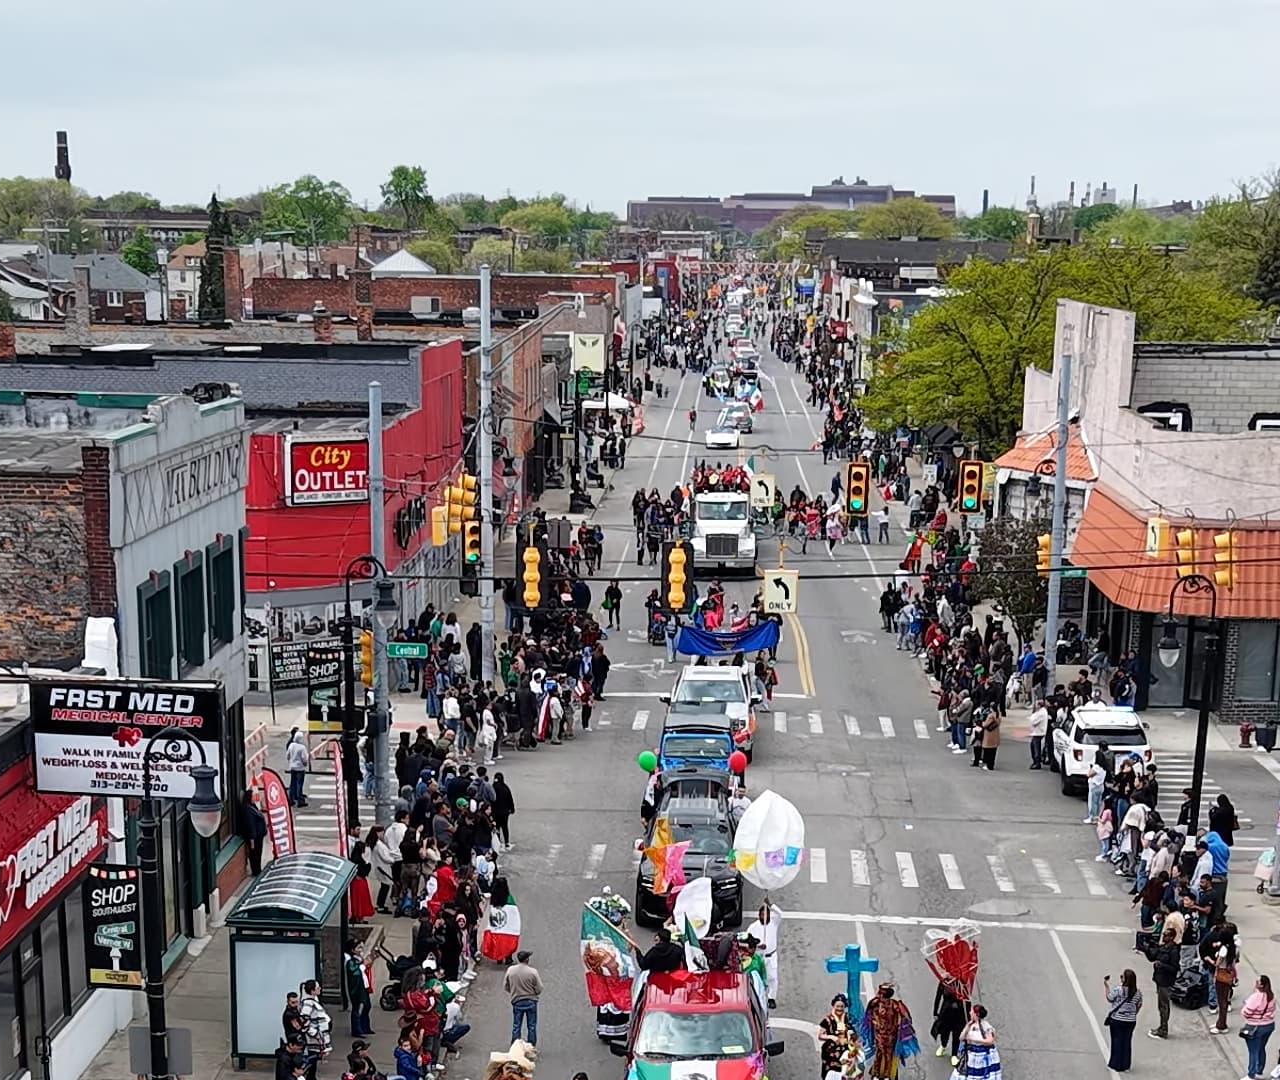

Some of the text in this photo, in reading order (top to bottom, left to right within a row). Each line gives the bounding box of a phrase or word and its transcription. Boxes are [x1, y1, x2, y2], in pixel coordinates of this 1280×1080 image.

[310, 446, 351, 470] City
[295, 469, 366, 491] OUTLET
[768, 601, 793, 610] ONLY
[395, 645, 419, 656] Central
[309, 662, 338, 678] SHOP
[50, 688, 195, 713] FAST MED
[52, 708, 203, 728] MEDICAL CENTER
[62, 748, 90, 757] WALK
[94, 749, 104, 757] IN
[106, 750, 141, 760] FAMILY
[42, 758, 108, 769] WEIGHT-LOSS
[95, 772, 140, 782] MEDICAL
[17, 796, 92, 888] FAST MED
[91, 884, 136, 907] SHOP
[92, 902, 138, 918] SOUTHWEST
